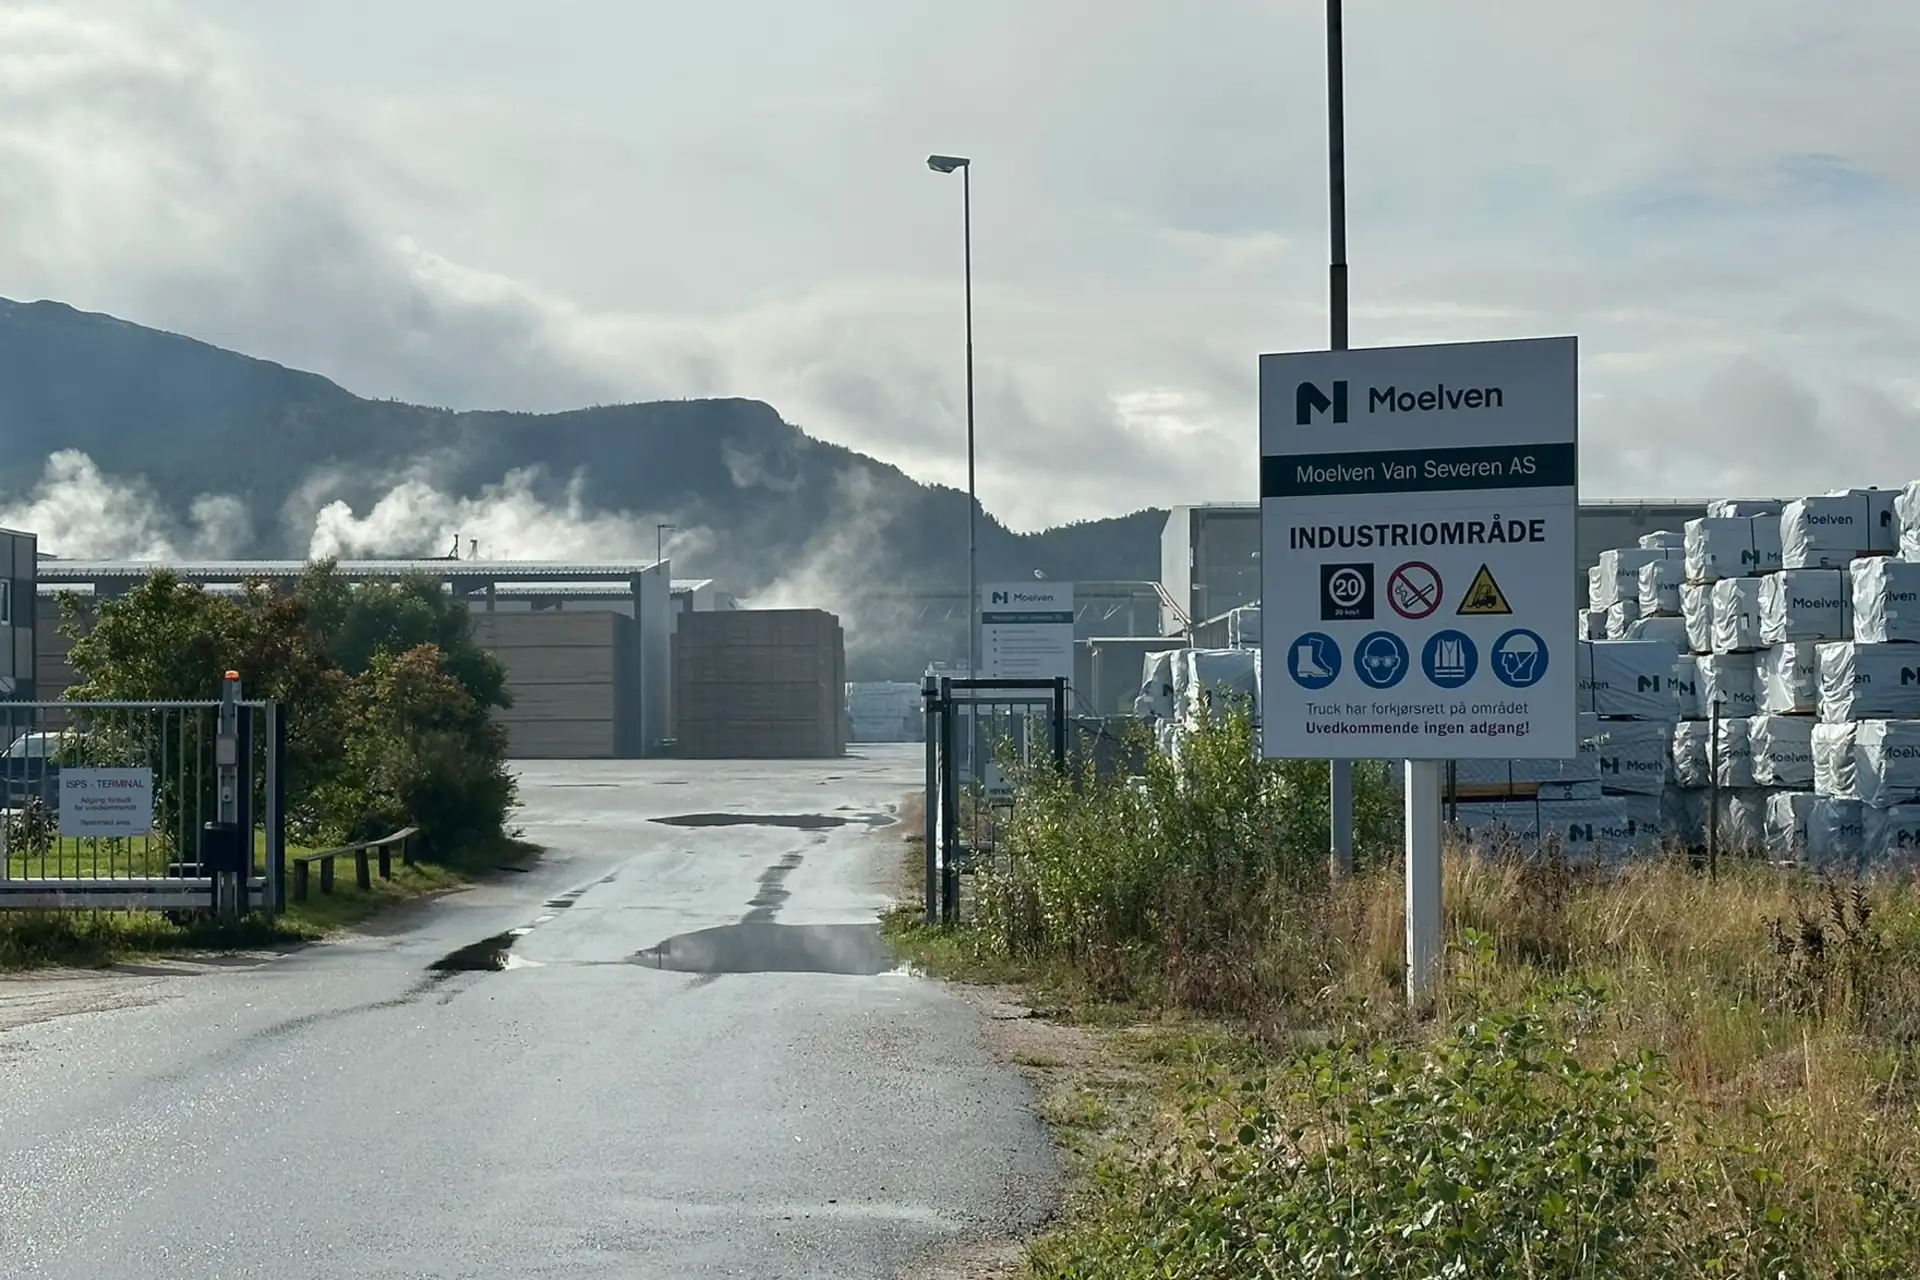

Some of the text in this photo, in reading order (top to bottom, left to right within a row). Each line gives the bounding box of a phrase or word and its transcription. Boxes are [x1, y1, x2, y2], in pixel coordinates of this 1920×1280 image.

[1369, 384, 1503, 413] Moelven
[1296, 456, 1536, 483] Moelven Van Severen AS
[1290, 513, 1546, 549] INDUSTRIOMRÅDE
[1336, 579, 1359, 596] 20
[1014, 591, 1054, 602] Moelven
[1307, 701, 1529, 717] Truck har forkjørsrett på området
[1306, 721, 1530, 737] Uvedkommende ingen adgang!
[66, 780, 88, 788] ISPS
[97, 780, 145, 788] TERMINAL
